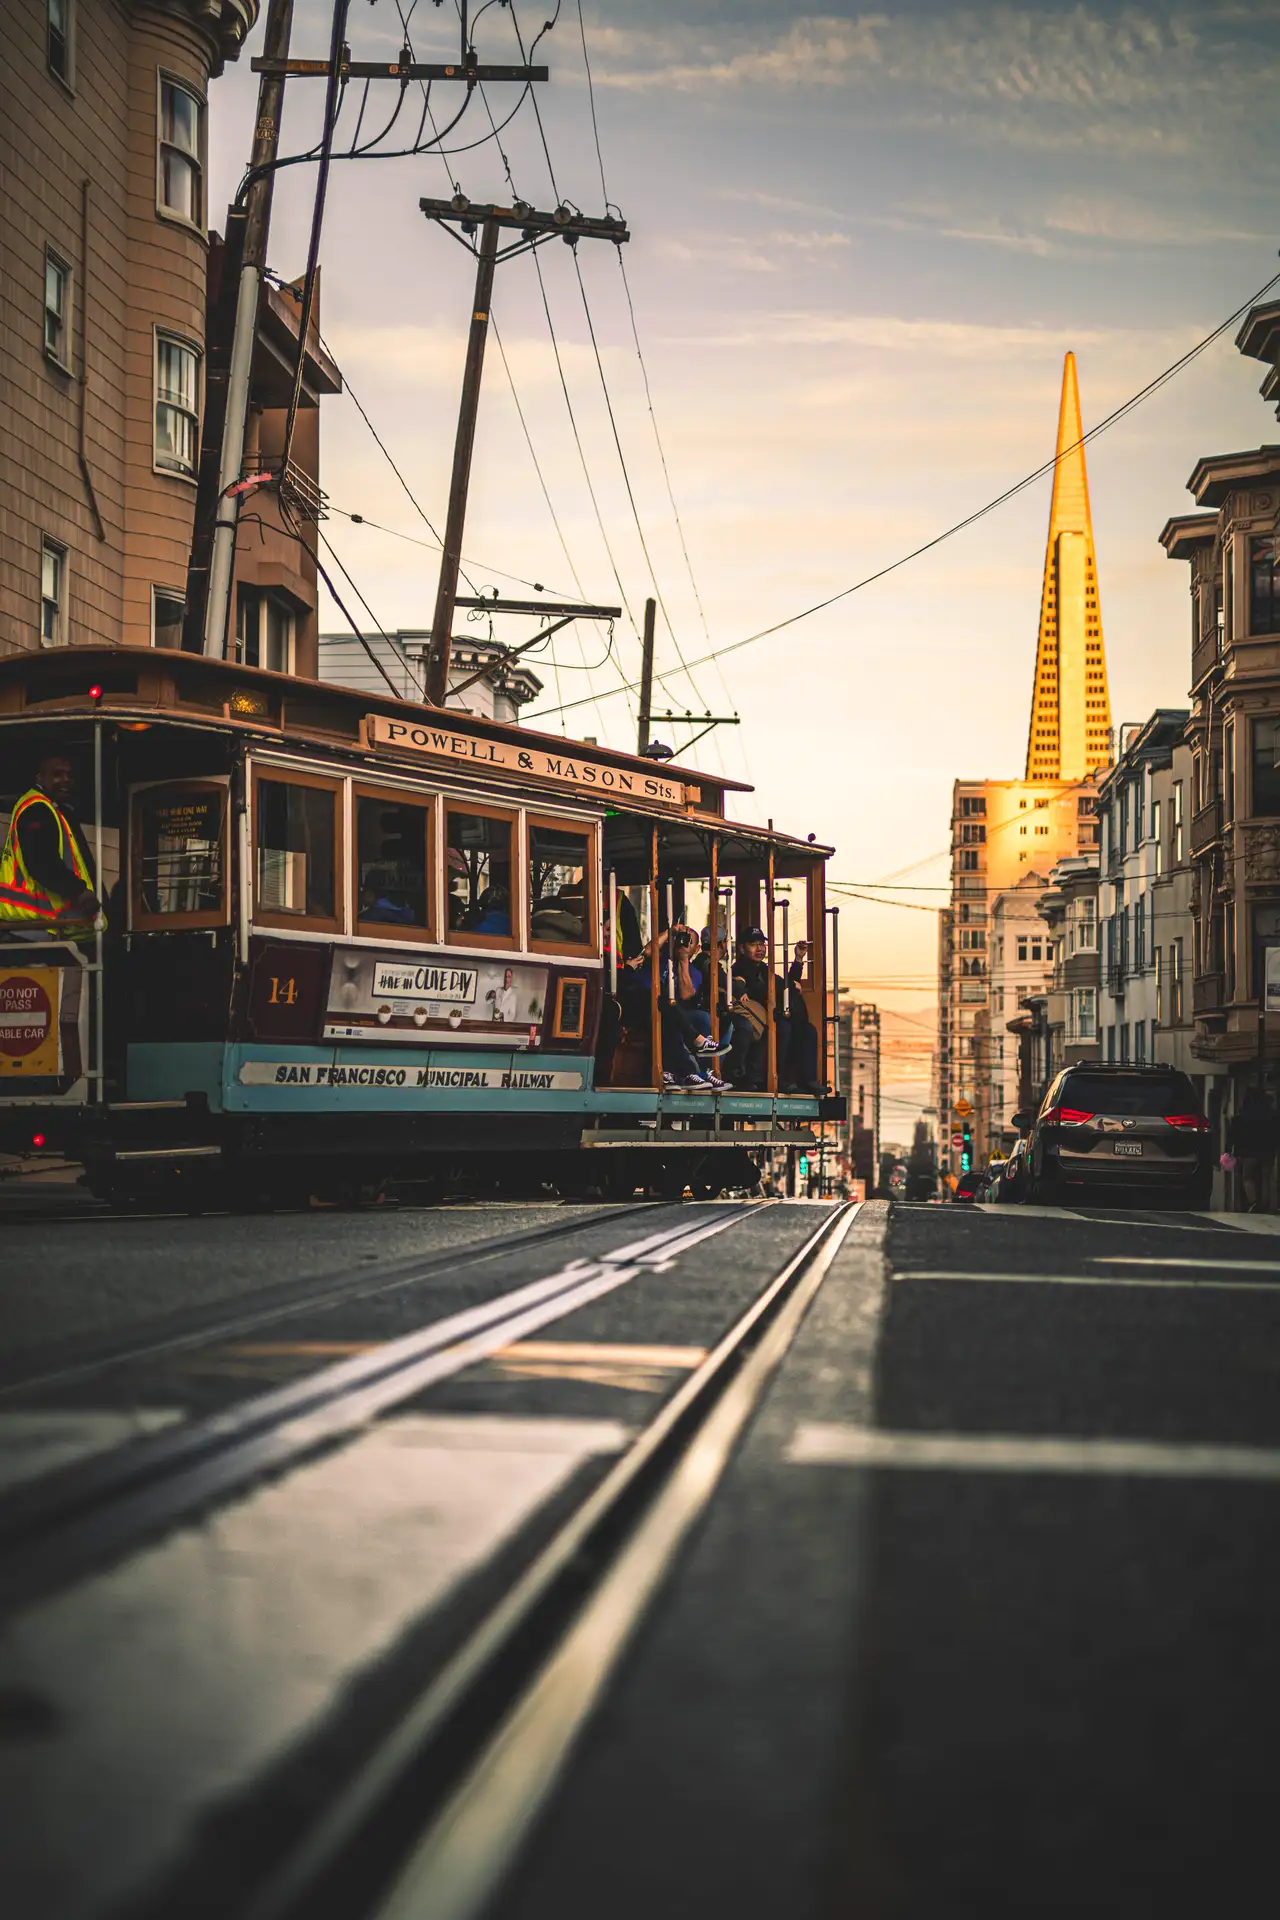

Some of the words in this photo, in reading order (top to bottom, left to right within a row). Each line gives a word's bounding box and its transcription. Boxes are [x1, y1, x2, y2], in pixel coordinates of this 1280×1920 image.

[388, 723, 505, 763] POWELL
[517, 752, 534, 770] &
[546, 758, 633, 790] MASON
[644, 780, 676, 799] Sts.
[0, 988, 14, 999] DO
[16, 988, 39, 999] NOT
[268, 977, 298, 1004] 14
[449, 971, 472, 999] DAY
[5, 999, 32, 1011] PASS
[0, 1028, 21, 1039] ABLE
[24, 1028, 44, 1038] CAR
[275, 1066, 311, 1083] SAN
[316, 1067, 407, 1086] FRANCISCO
[416, 1070, 489, 1087] MUNICIPAL
[500, 1073, 555, 1089] RAILWAY
